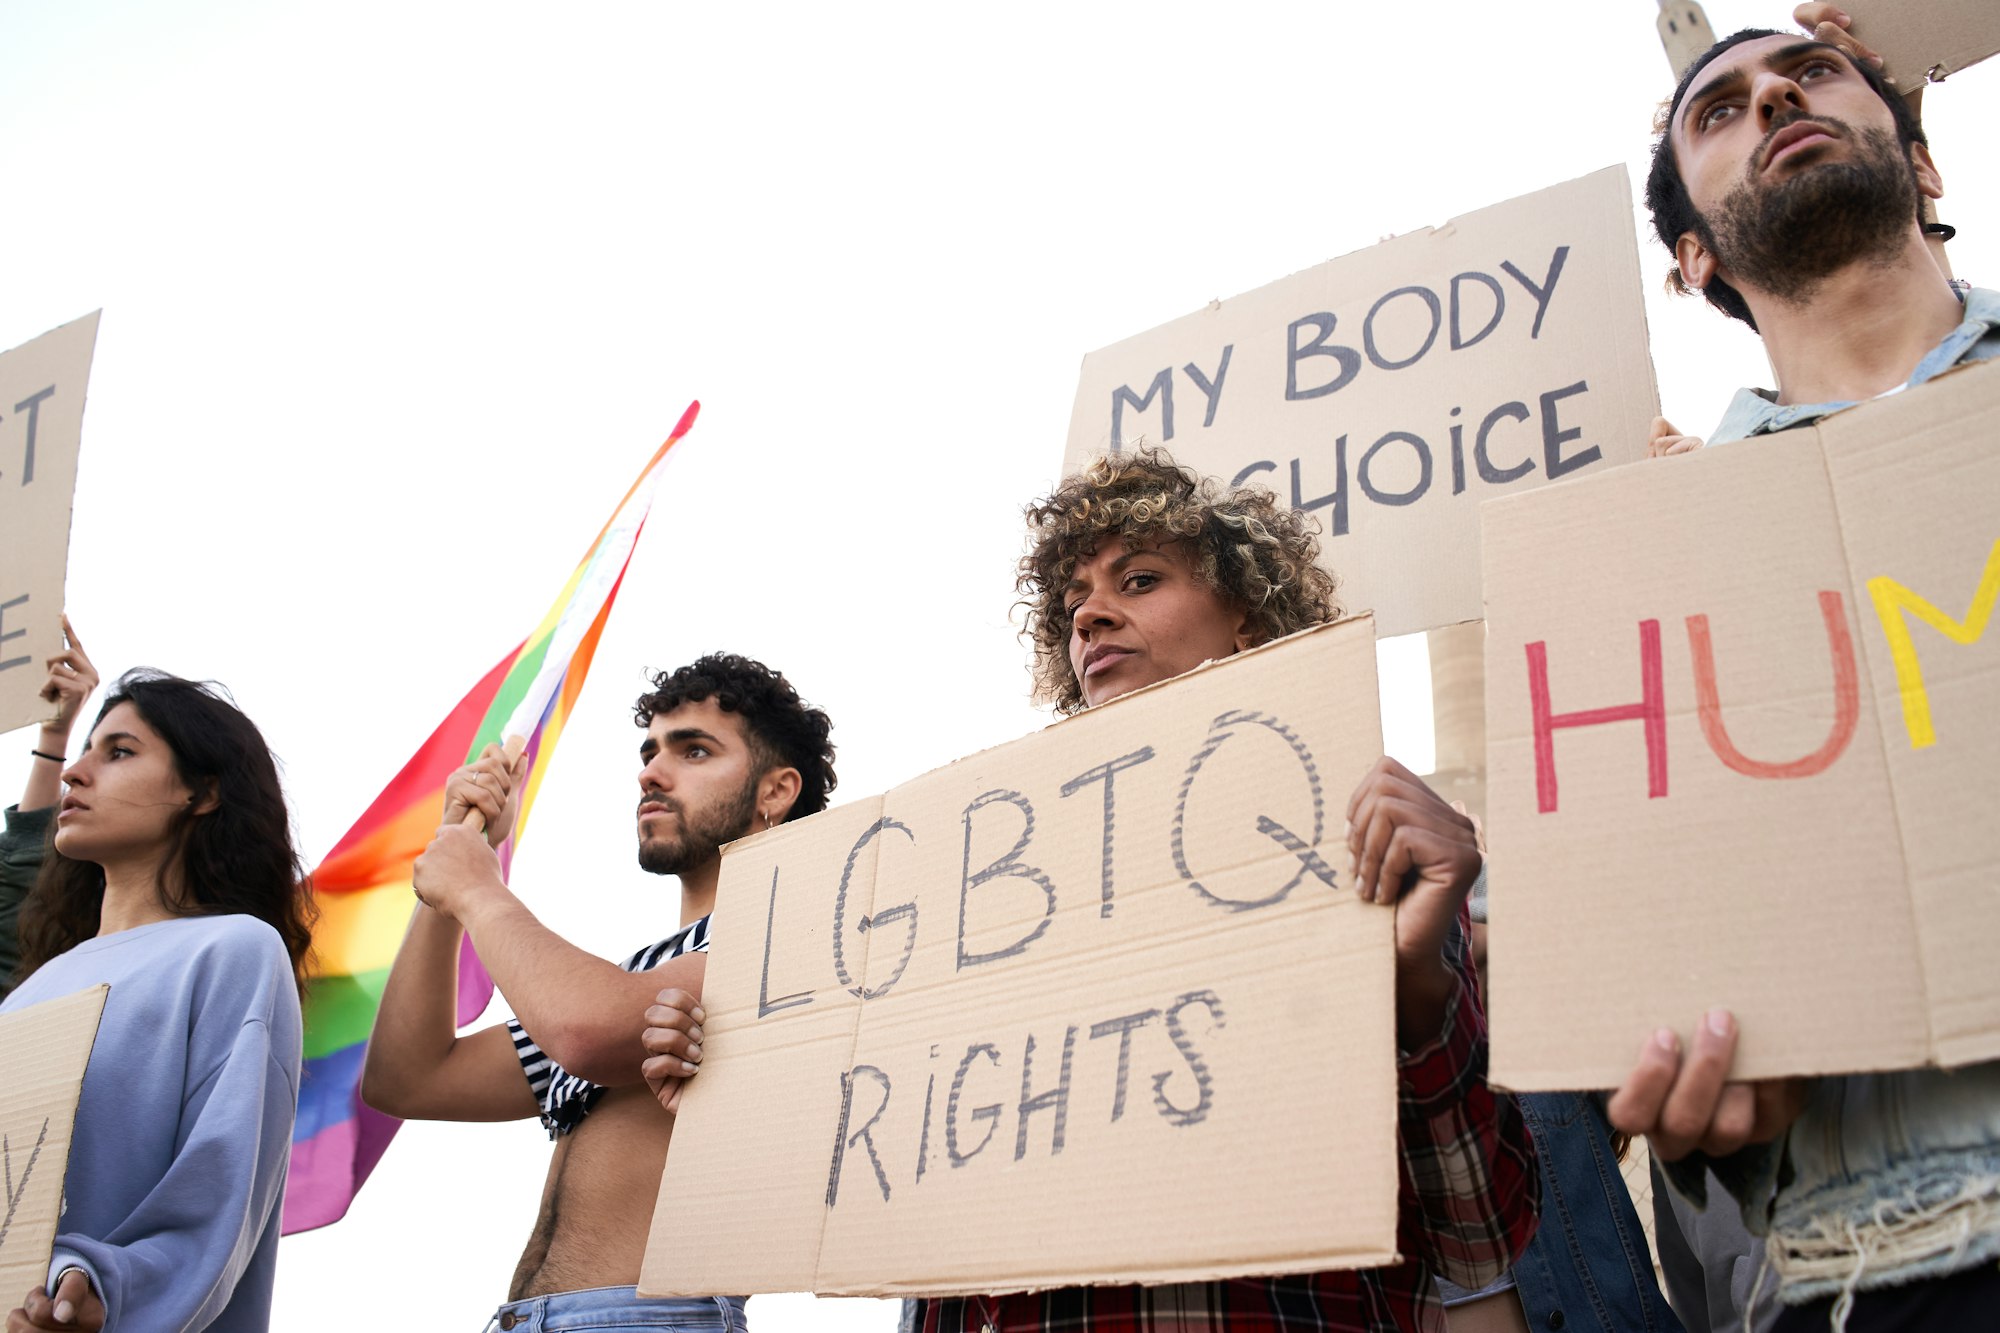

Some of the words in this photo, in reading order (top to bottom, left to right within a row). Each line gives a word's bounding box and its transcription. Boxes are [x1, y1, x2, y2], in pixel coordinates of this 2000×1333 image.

[0, 383, 56, 487] T
[1110, 344, 1234, 453] MY
[1285, 246, 1570, 401] BODY
[1525, 537, 2000, 814] HUM
[757, 709, 1338, 1019] LGBTQ
